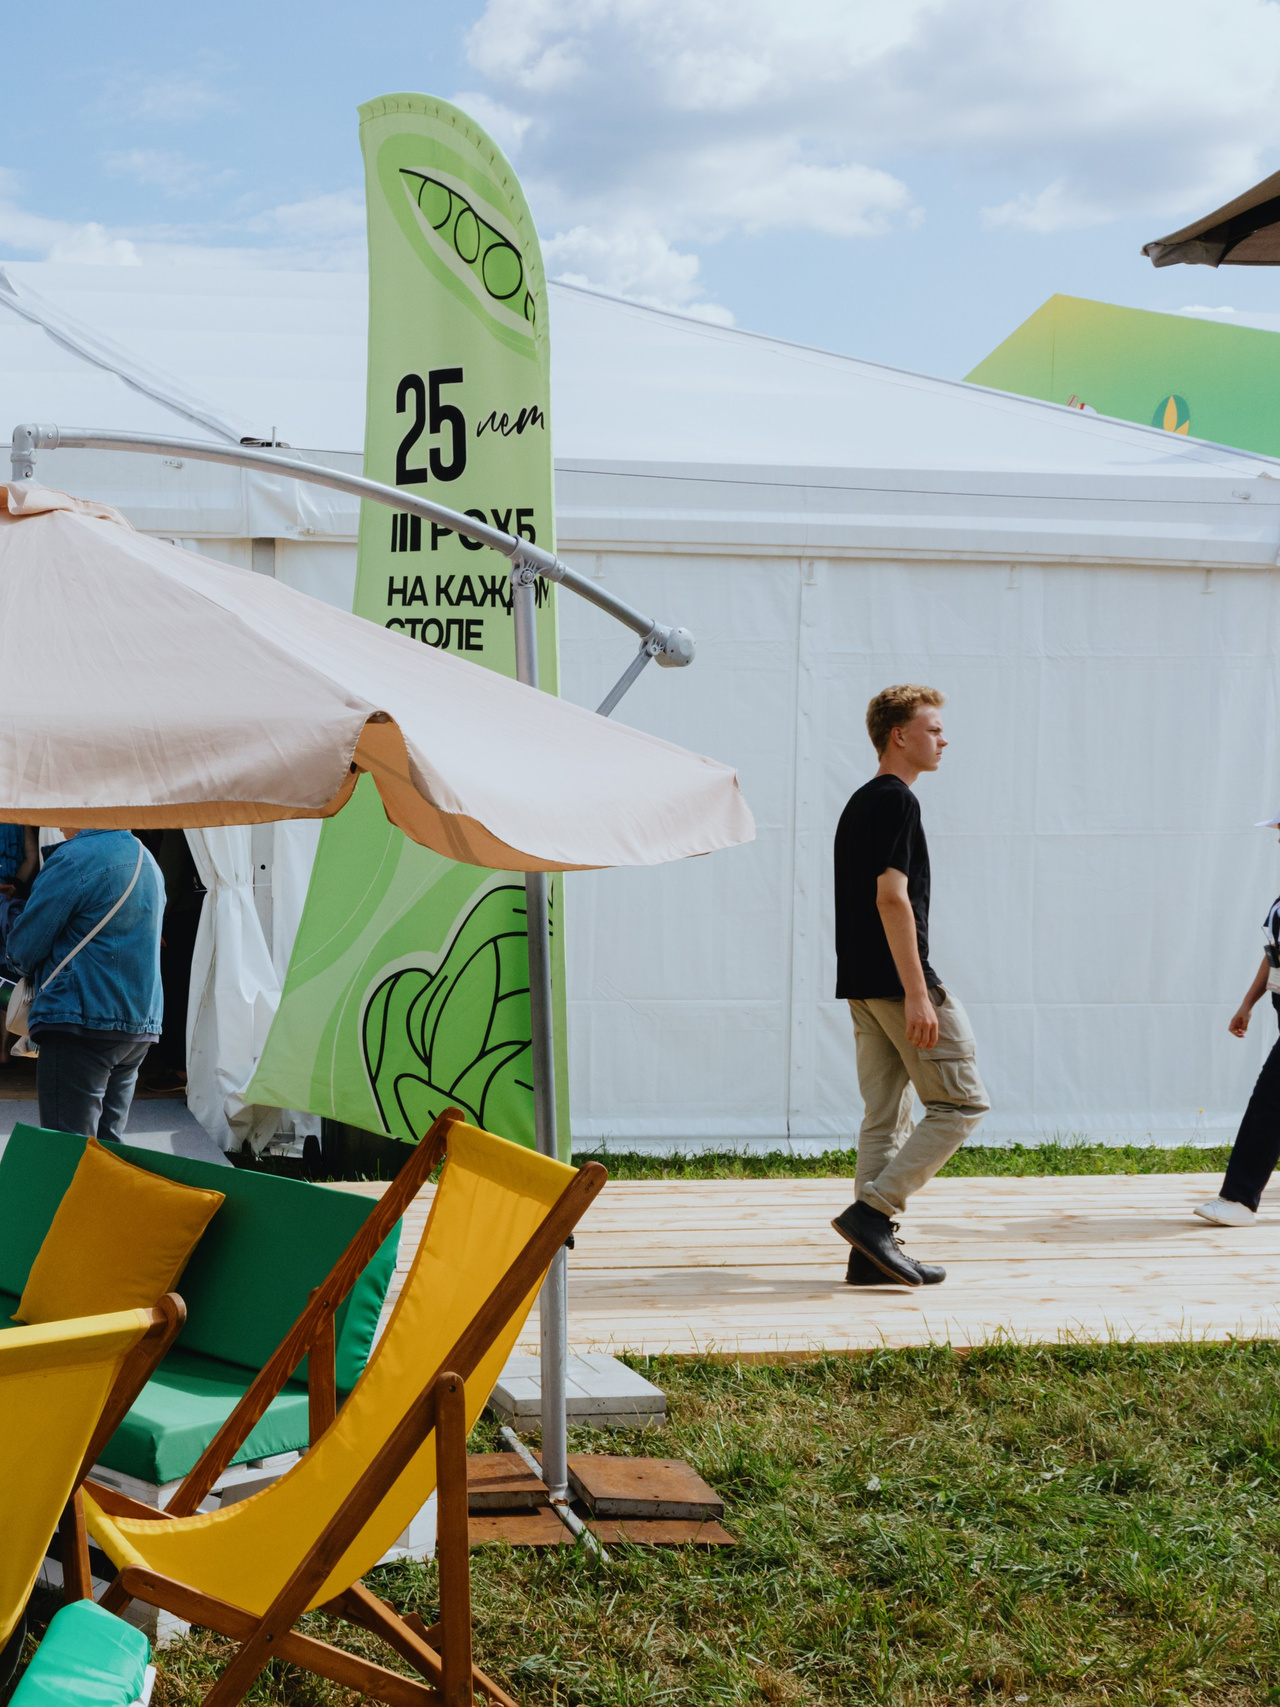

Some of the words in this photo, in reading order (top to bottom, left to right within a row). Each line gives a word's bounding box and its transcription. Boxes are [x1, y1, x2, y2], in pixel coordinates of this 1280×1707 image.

[395, 367, 467, 485] 25
[476, 405, 545, 437] лет
[387, 575, 429, 606] НА
[435, 575, 550, 615] КАЖМ
